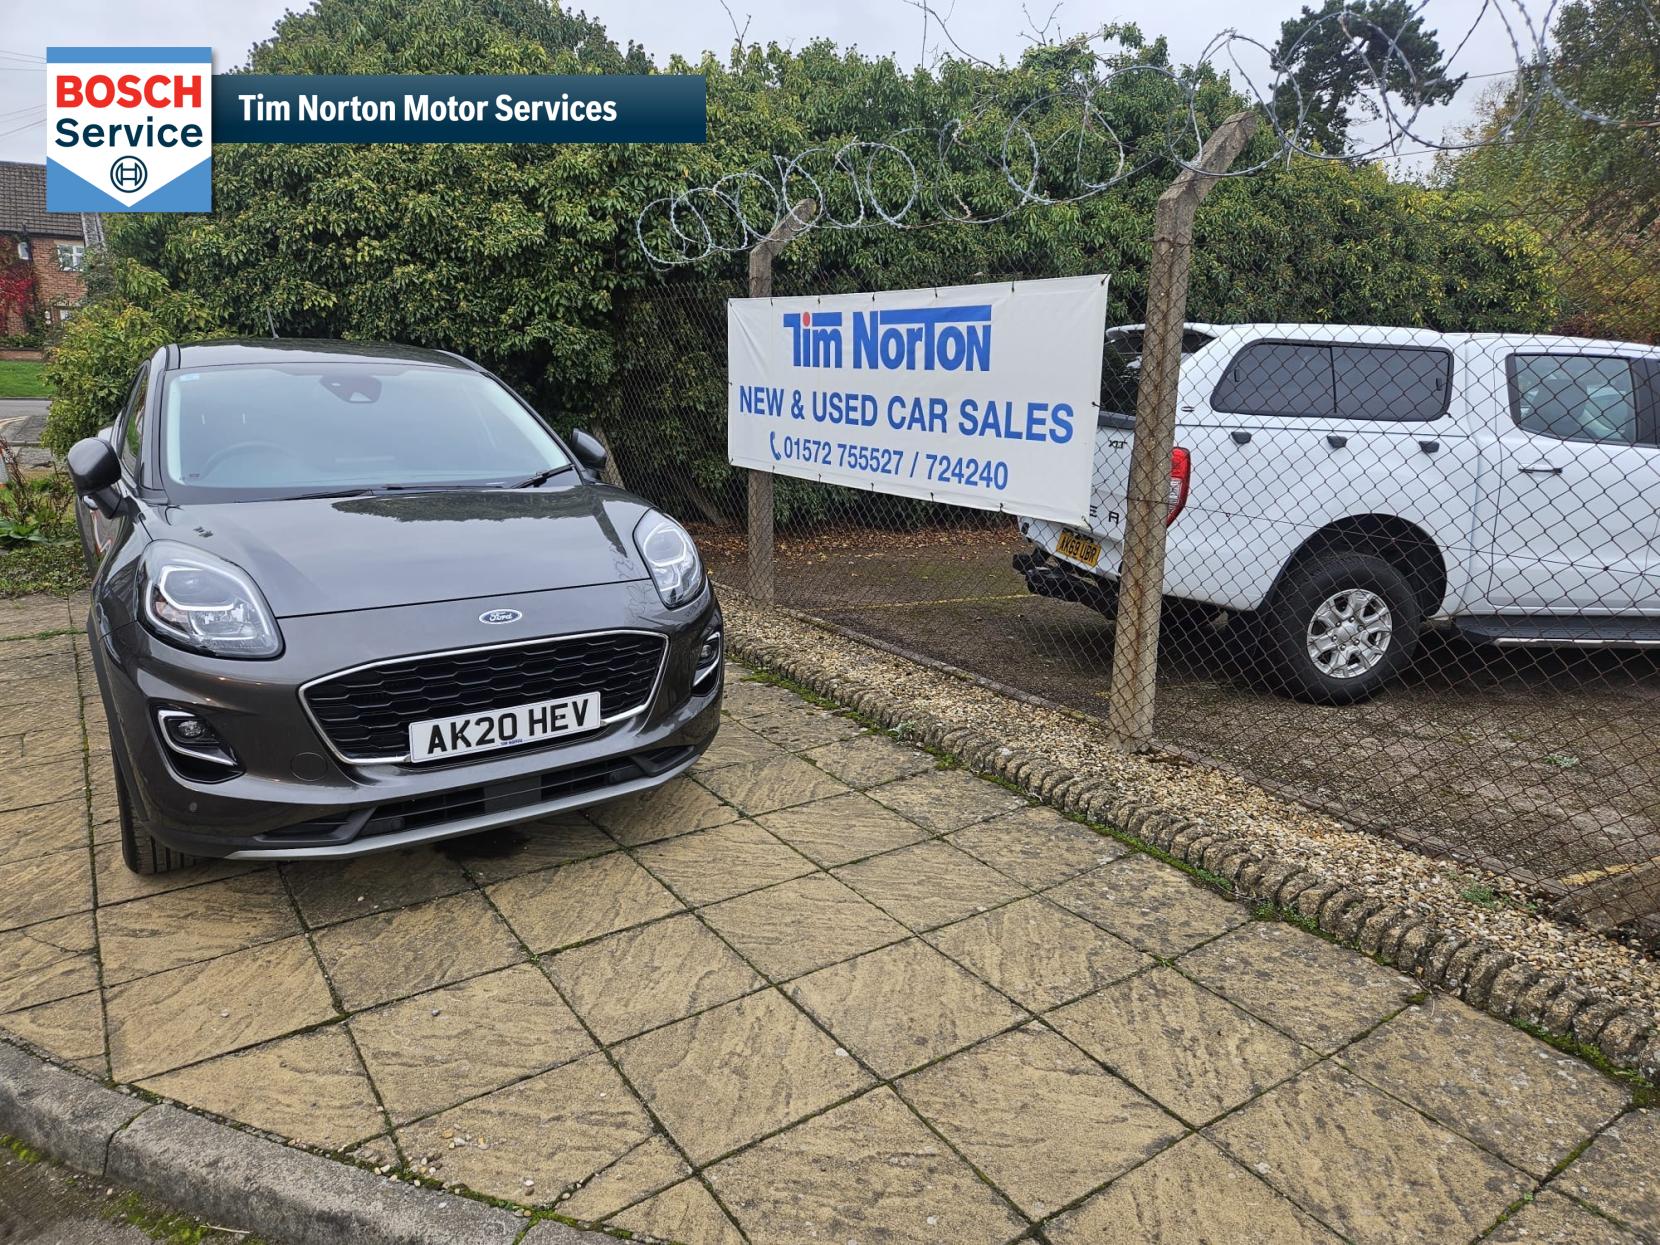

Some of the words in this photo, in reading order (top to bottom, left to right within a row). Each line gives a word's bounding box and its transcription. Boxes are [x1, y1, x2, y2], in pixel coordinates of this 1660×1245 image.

[783, 311, 842, 369] Tim
[739, 385, 784, 418] NEW
[790, 389, 805, 420] &
[812, 391, 878, 427] USED
[887, 395, 948, 433] CAR
[958, 398, 1074, 444] SALES
[784, 434, 832, 466] 01572
[837, 442, 904, 478] 755527
[909, 451, 920, 479] /
[925, 453, 1009, 491] 724240
[489, 611, 513, 622] Ford
[427, 712, 518, 755] AK20
[528, 699, 589, 737] HEV
